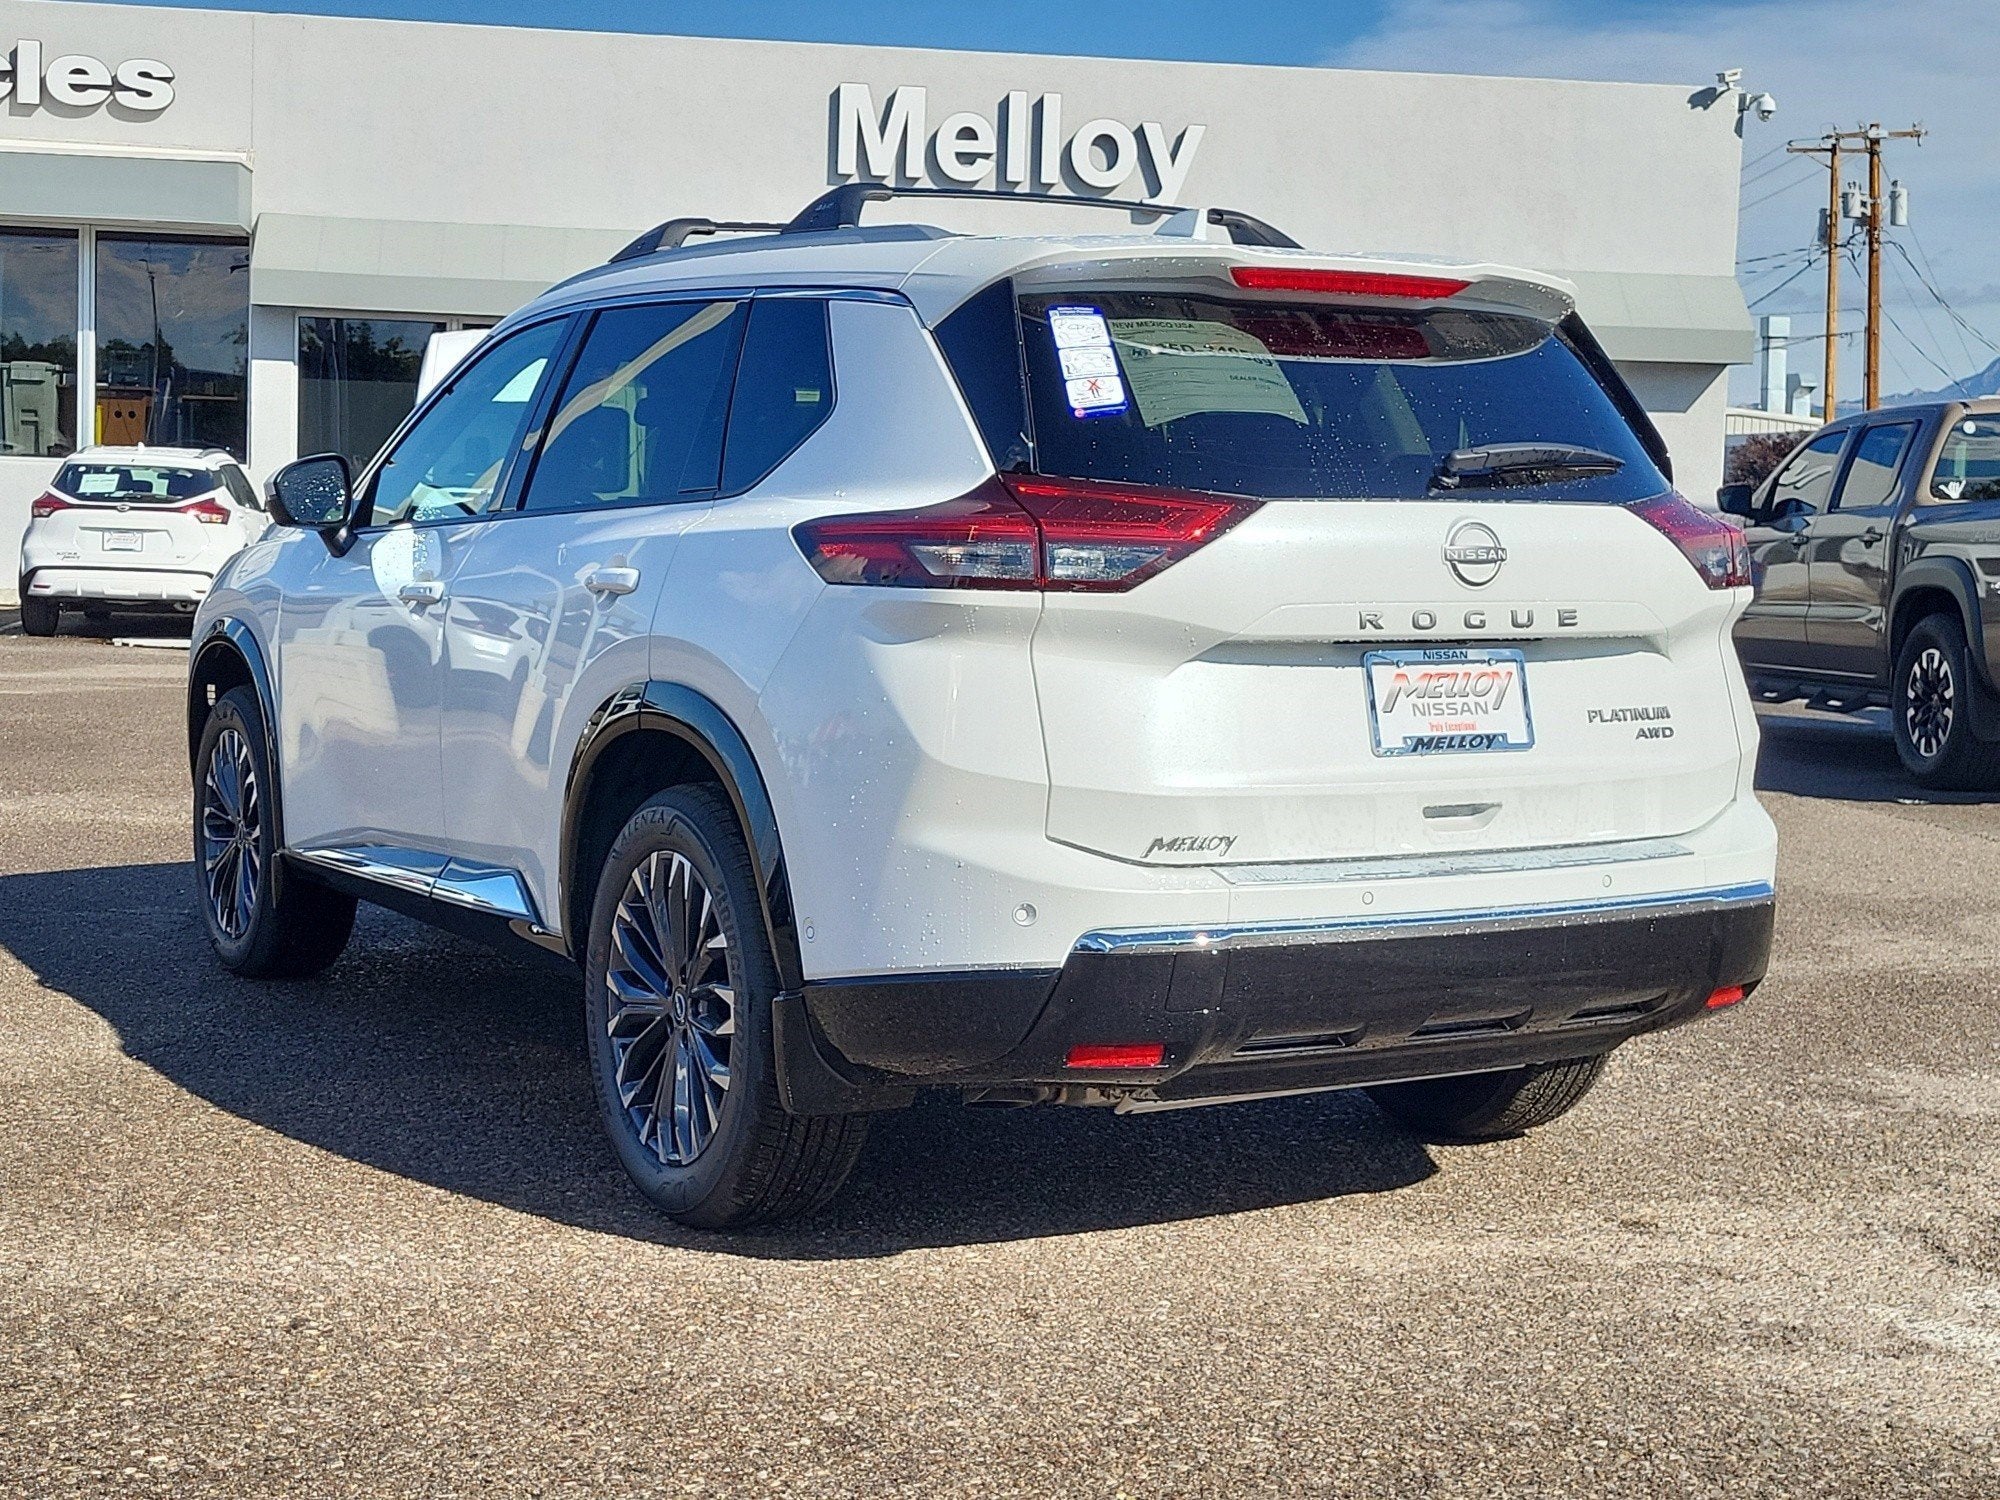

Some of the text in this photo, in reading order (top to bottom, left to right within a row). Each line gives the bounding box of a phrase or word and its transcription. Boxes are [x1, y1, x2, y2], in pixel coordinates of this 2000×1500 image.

[0, 39, 175, 111] les
[836, 82, 1208, 205] Melloy
[1446, 549, 1508, 561] NISSAN
[1358, 608, 1579, 630] ROGUE
[1422, 650, 1468, 660] NISSAN
[1381, 671, 1513, 714] MELLOY
[1411, 701, 1490, 718] NISSAN
[1587, 706, 1672, 724] PLATINUM
[1635, 726, 1675, 740] AWD
[1410, 734, 1499, 754] MELLOY
[1140, 835, 1238, 858] MELLOY
